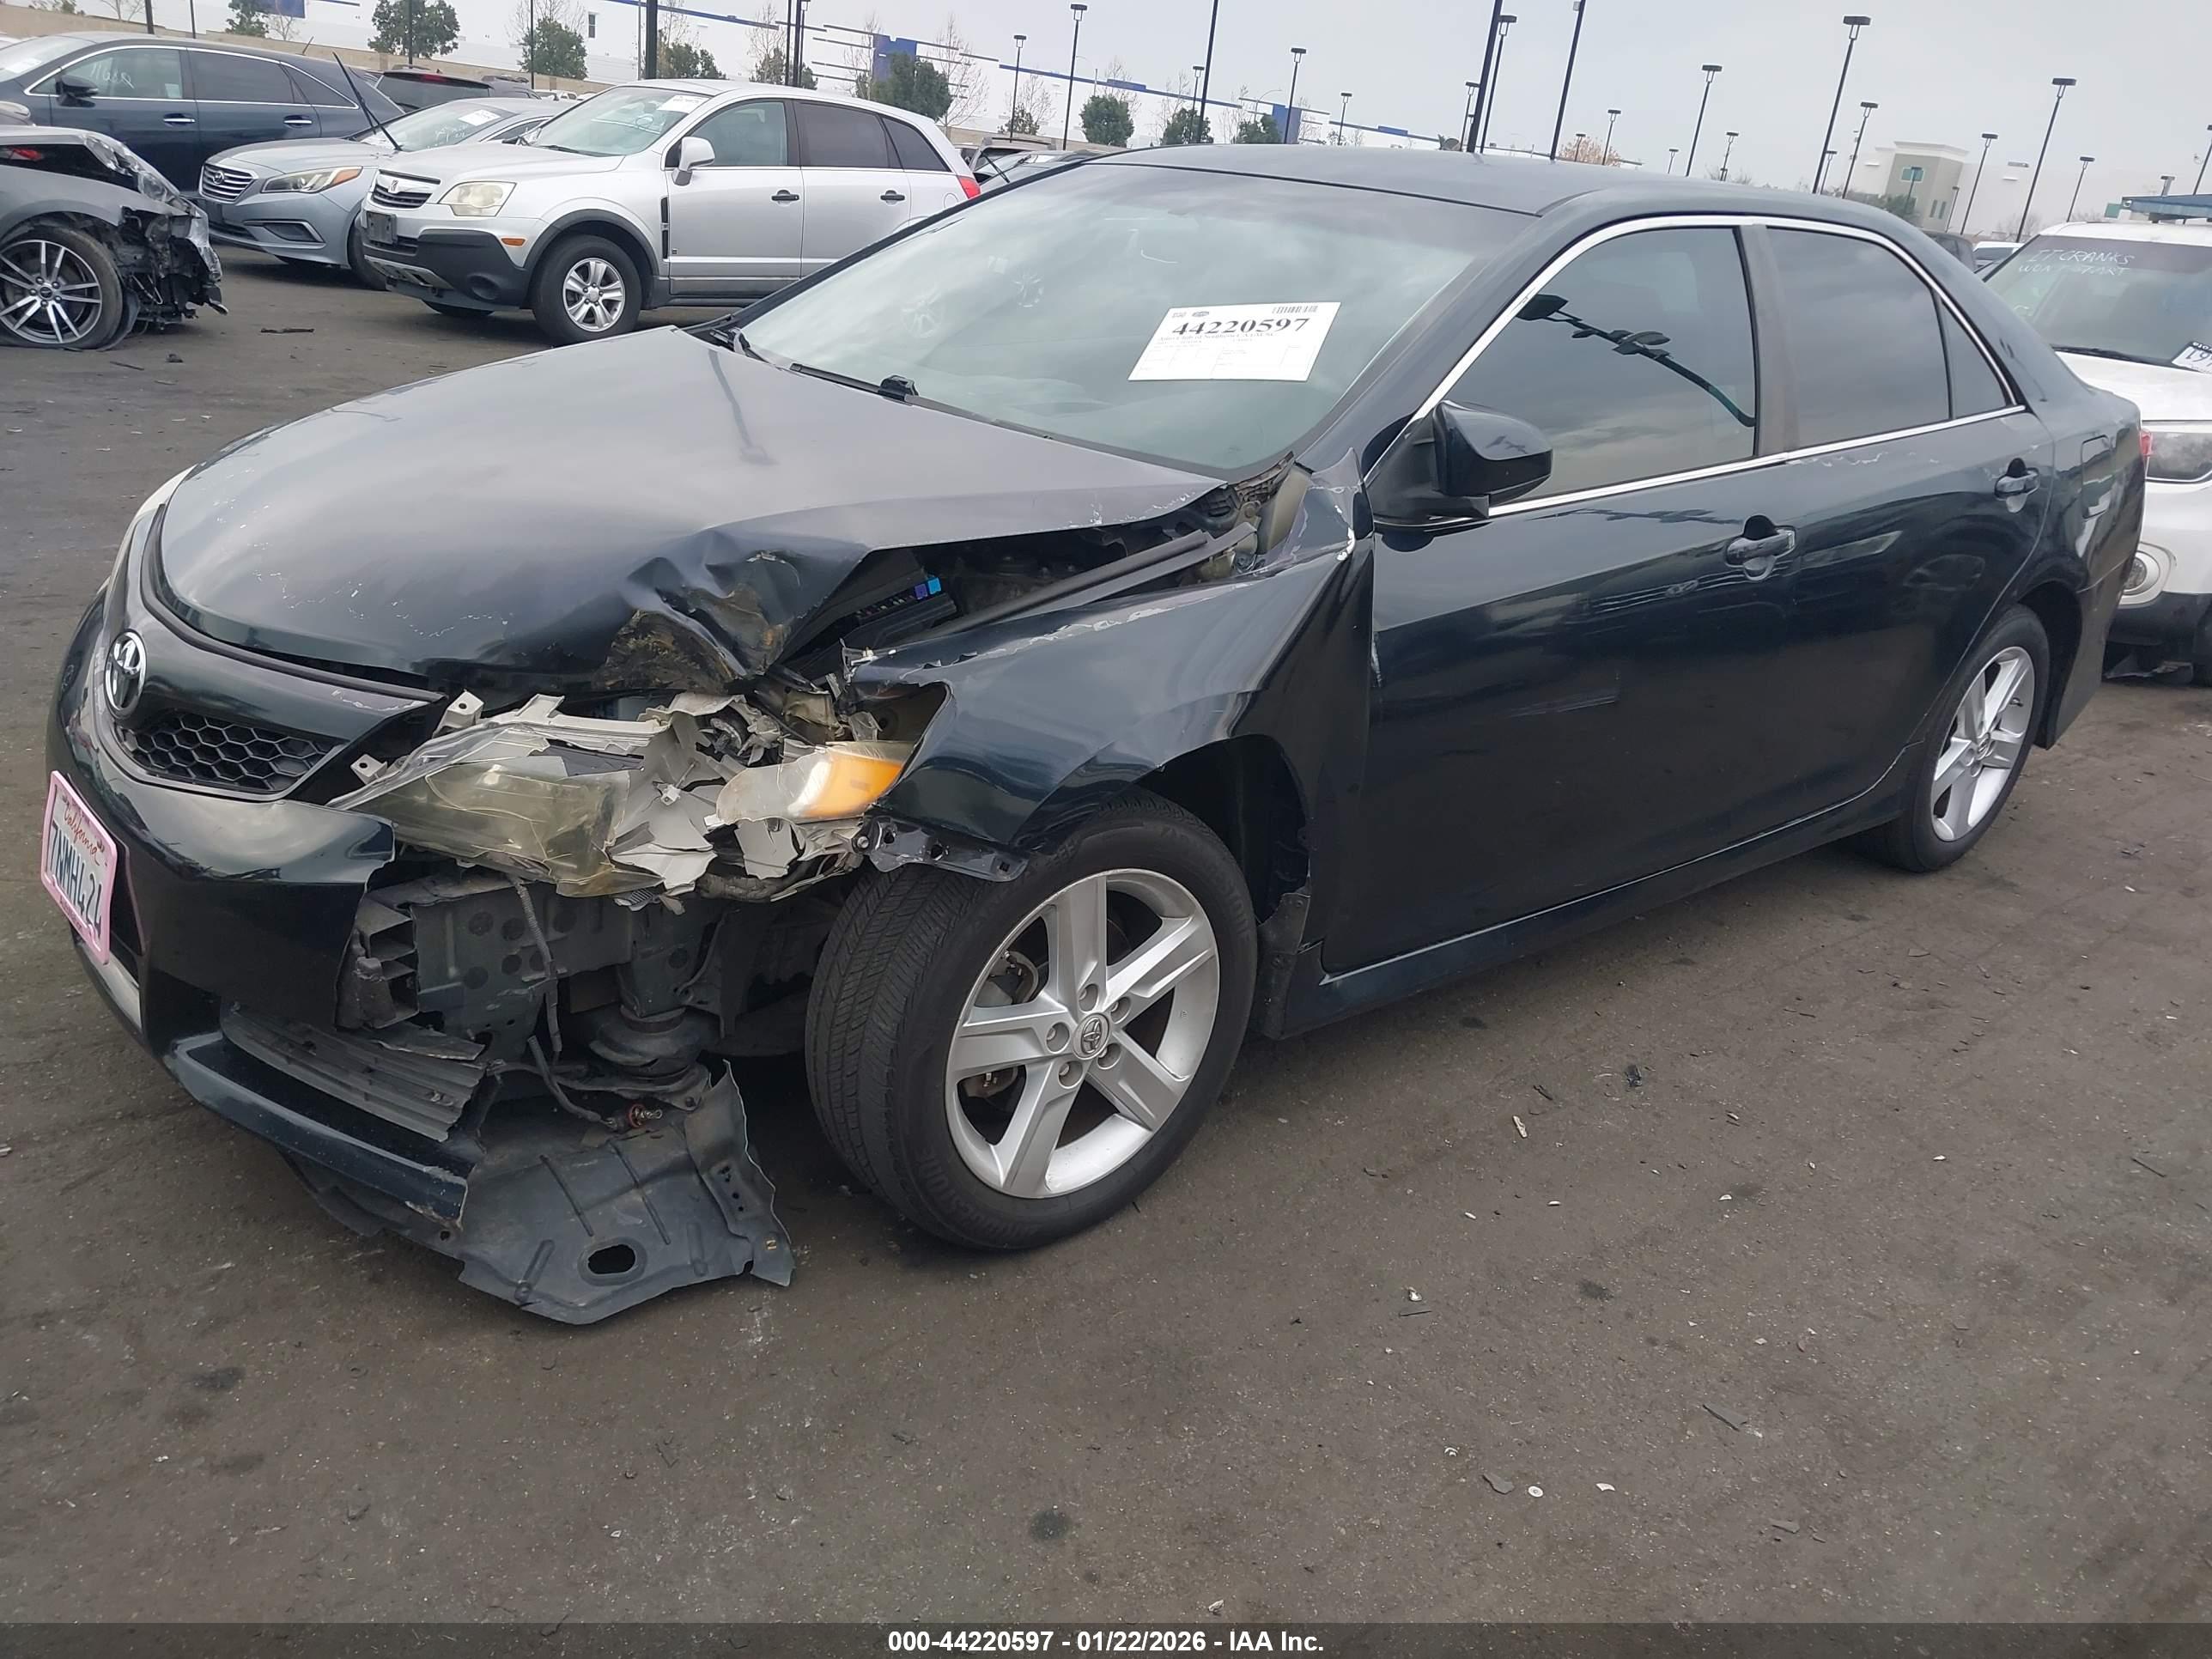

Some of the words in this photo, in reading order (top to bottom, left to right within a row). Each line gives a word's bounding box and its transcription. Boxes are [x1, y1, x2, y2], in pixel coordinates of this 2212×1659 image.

[2059, 250, 2136, 264] CRANKS
[1172, 317, 1310, 336] 44220597
[62, 802, 100, 866] California
[48, 820, 103, 939] 7NMH424
